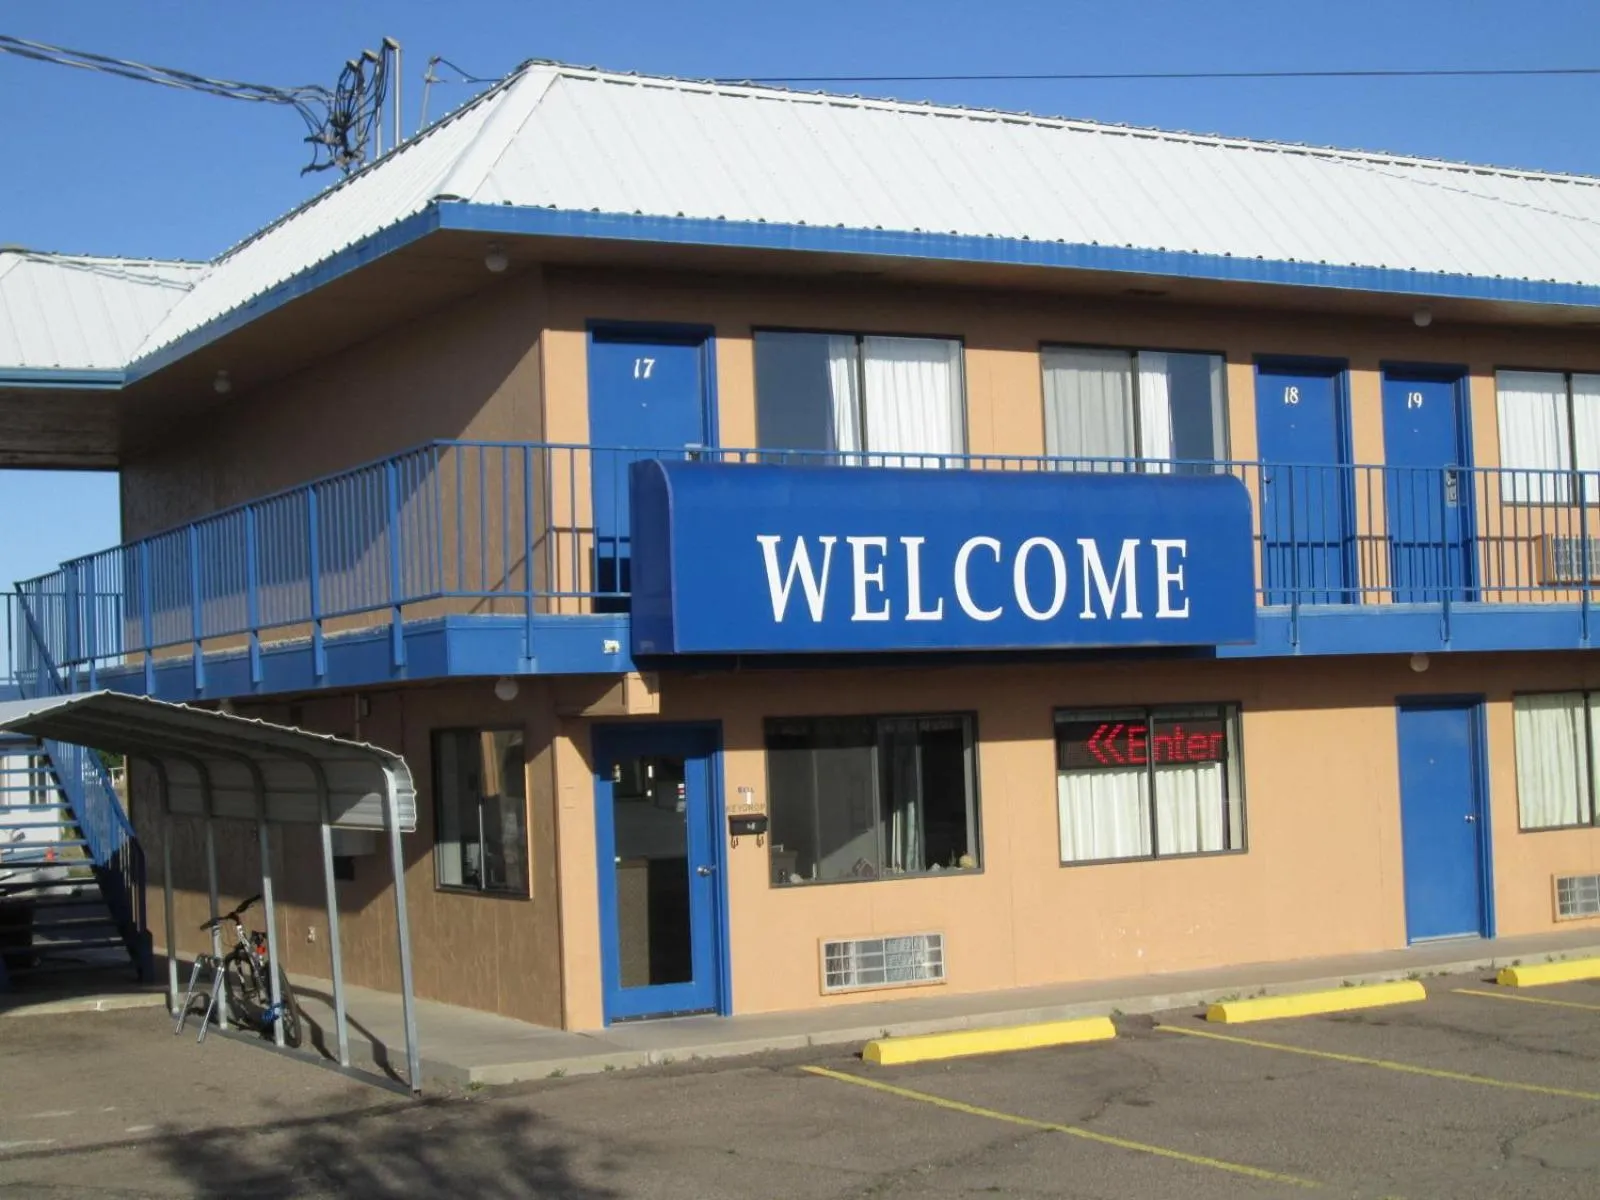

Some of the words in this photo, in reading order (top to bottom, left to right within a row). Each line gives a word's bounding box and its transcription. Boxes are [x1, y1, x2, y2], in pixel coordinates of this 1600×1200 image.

[633, 357, 656, 380] 17
[1284, 386, 1300, 405] 18
[1407, 392, 1423, 409] 19
[756, 535, 1190, 622] WELCOME
[1127, 725, 1223, 764] Enter
